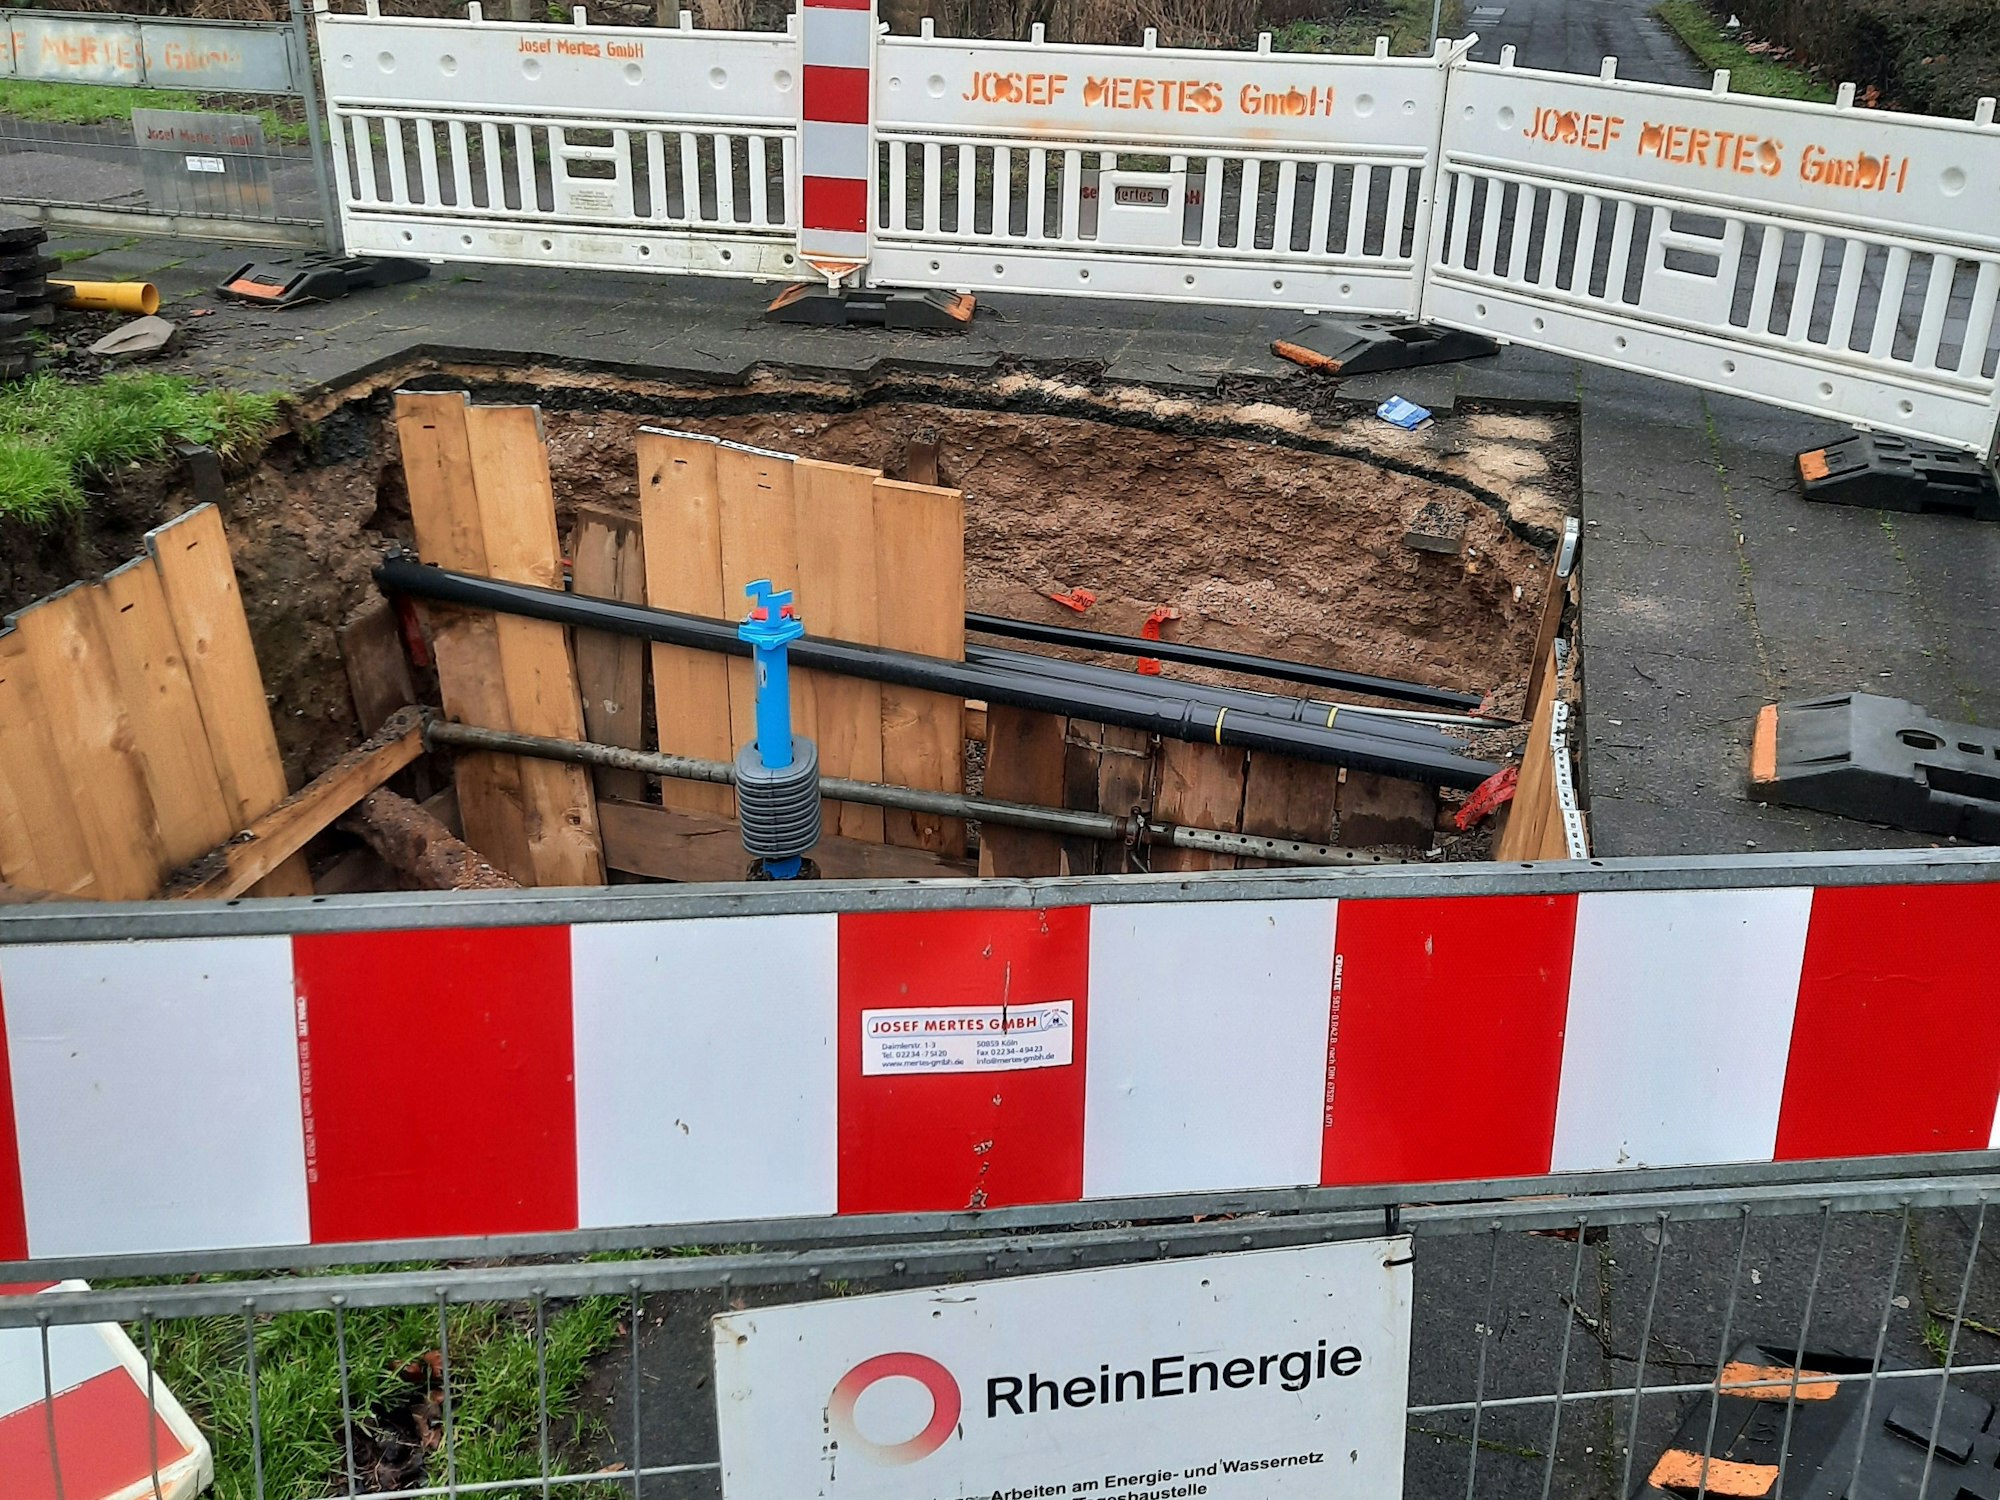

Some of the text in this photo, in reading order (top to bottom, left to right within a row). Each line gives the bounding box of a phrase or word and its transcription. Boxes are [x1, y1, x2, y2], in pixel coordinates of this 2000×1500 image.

[518, 36, 644, 59] Josef Mertes GmbH
[962, 71, 1335, 117] JOSEF MERTES GmbH
[1523, 106, 1909, 193] JOSEF MERTES GmbH
[872, 1016, 1037, 1033] JOSEF MERTES GMBH
[976, 1052, 1055, 1065] info@mertes-gmbh.de
[1328, 1047, 1336, 1064] nach
[1327, 1066, 1335, 1079] DIN
[985, 1339, 1363, 1418] RheinEnergie
[991, 1451, 1325, 1500] Arbeiten am Energie- und Wassernetz
[1072, 1483, 1207, 1500] sbaustelle
